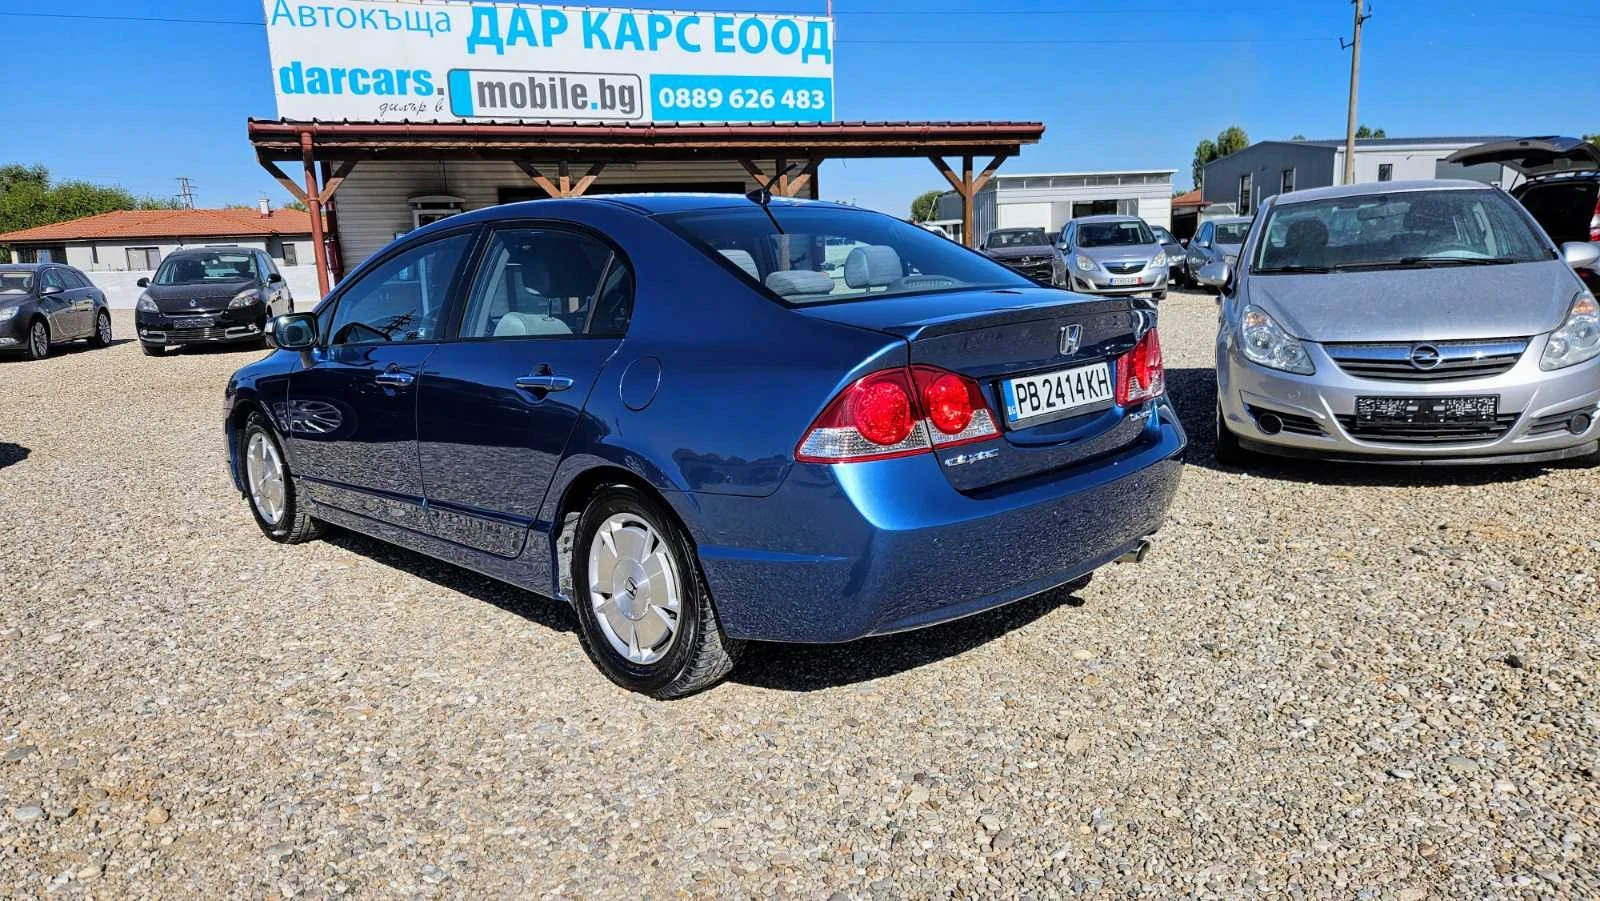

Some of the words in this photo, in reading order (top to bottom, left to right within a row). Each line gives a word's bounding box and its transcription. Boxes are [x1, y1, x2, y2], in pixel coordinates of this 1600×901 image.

[271, 0, 451, 38] Автокъща
[466, 6, 568, 55] ДАР
[582, 10, 701, 53] КАРС
[713, 17, 831, 64] ЕООД
[477, 76, 635, 114] mobile.bg
[658, 87, 723, 109] 0889
[729, 88, 776, 109] 626
[780, 89, 825, 110] 483
